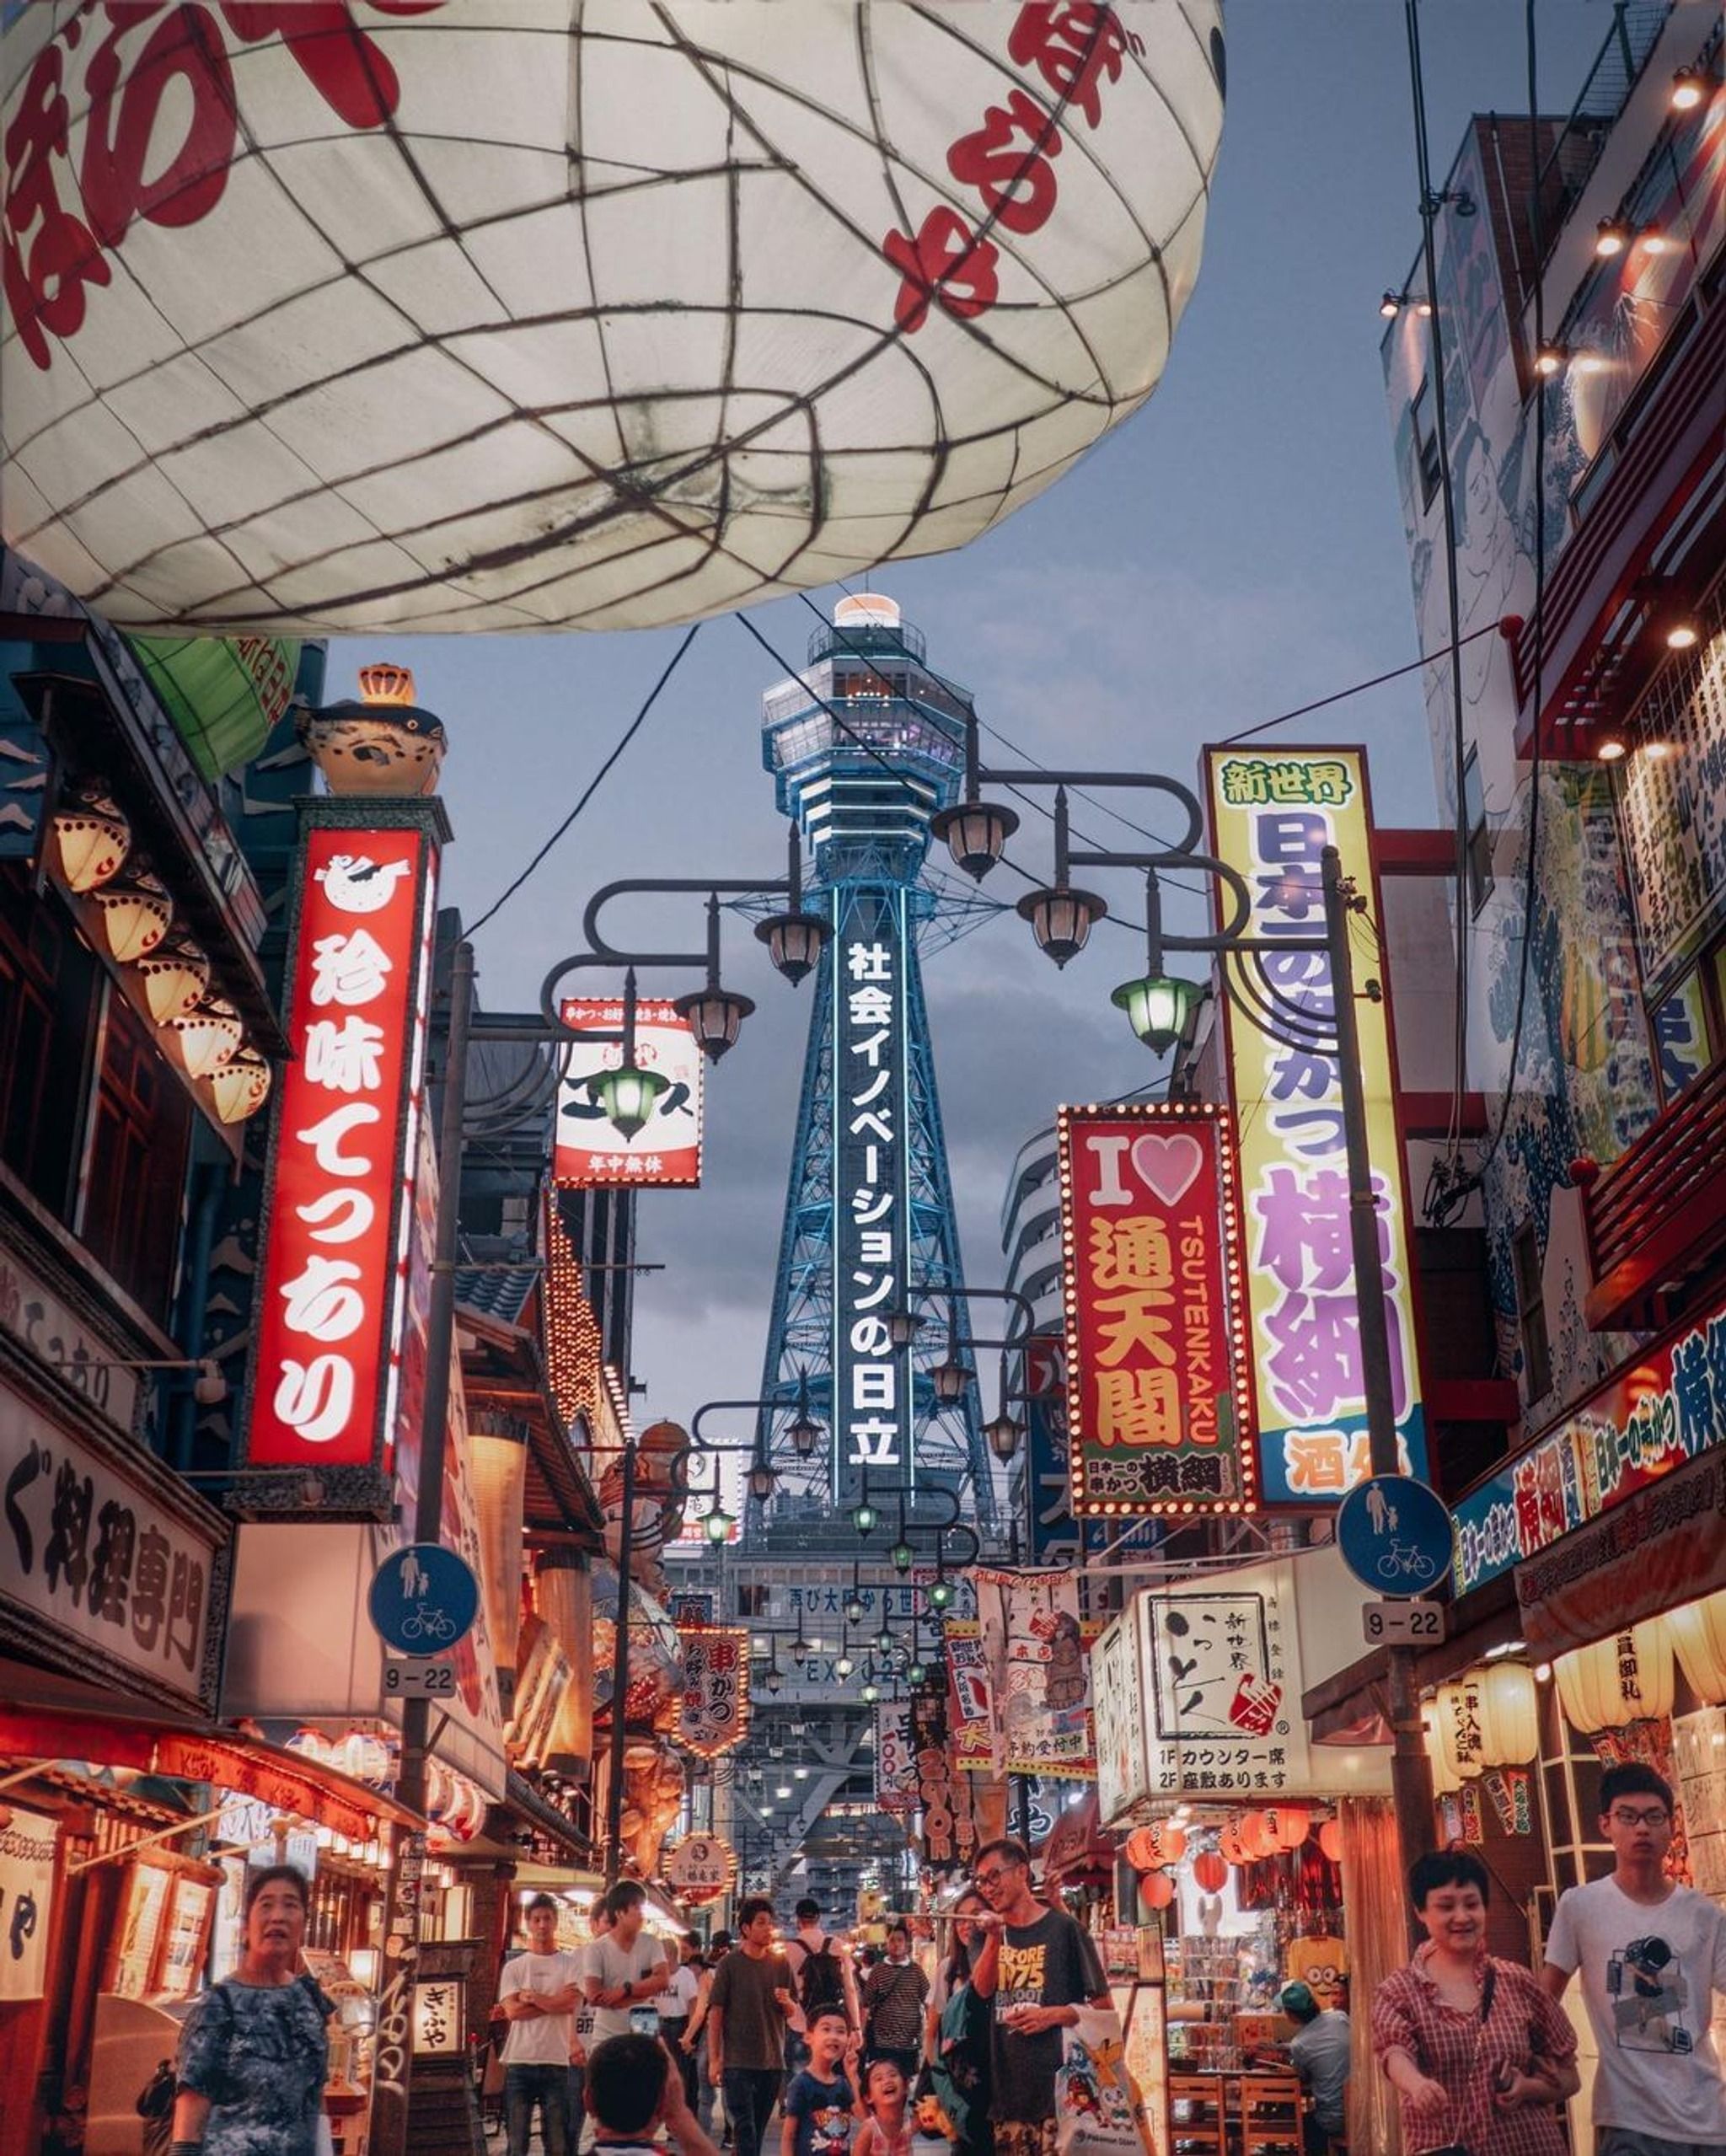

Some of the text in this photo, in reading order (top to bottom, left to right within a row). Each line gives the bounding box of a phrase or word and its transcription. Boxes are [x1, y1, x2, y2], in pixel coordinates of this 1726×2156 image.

[1223, 760, 1352, 805] 新世界
[588, 1155, 663, 1173] 年中無休
[1086, 1135, 1134, 1206] I
[848, 942, 899, 1466] 社会イノベーションの日立
[1179, 1215, 1217, 1443] TSUTENKAKU
[1090, 1461, 1138, 1473] 日本一の
[1090, 1477, 1138, 1493] 串かつ
[1225, 1612, 1252, 1671] 新世界
[707, 1642, 737, 1722] 串かつ
[1160, 1748, 1286, 1766] 1F カウンター席
[1160, 1772, 1287, 1789] 2F 座敷あります
[998, 1962, 1045, 1991] 1975
